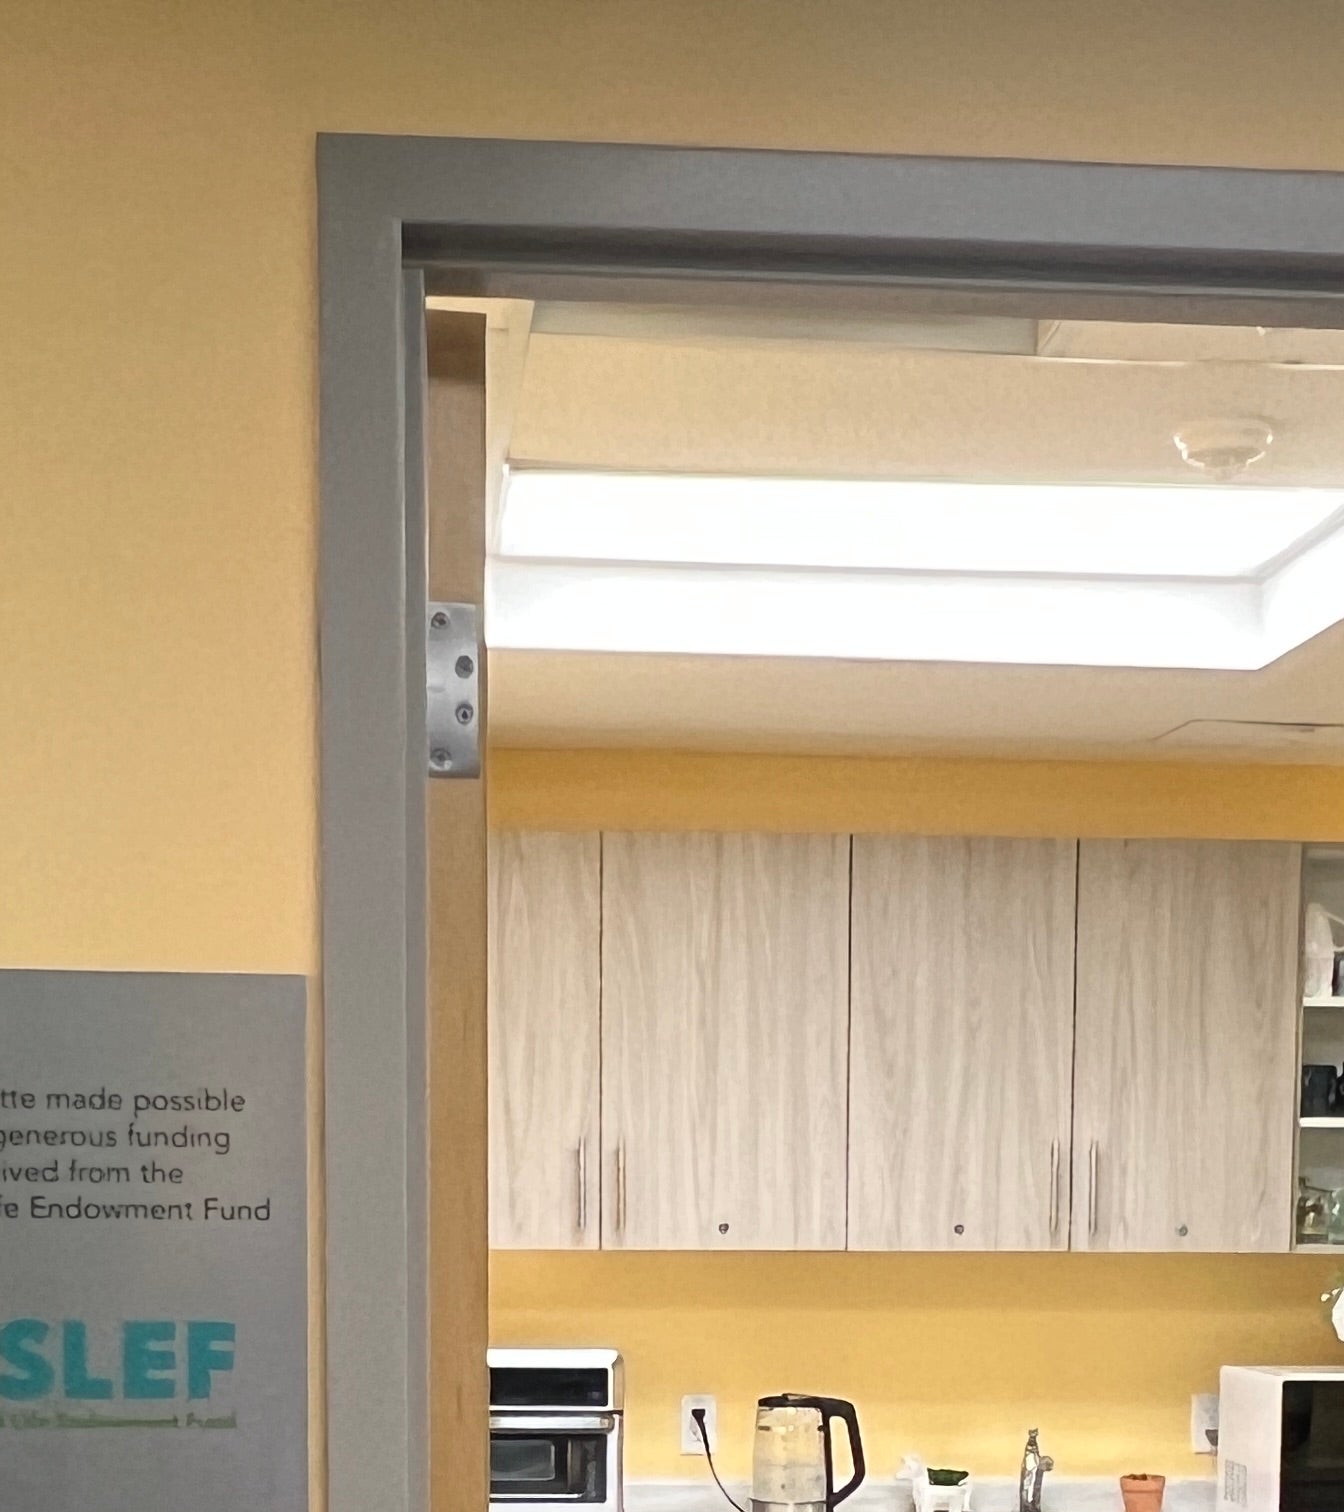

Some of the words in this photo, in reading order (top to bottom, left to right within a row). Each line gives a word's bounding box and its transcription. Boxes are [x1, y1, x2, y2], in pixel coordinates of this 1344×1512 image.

[46, 1086, 124, 1112] made
[131, 1088, 247, 1118] possible
[128, 1122, 232, 1155] funding
[69, 1160, 132, 1185] from
[141, 1162, 186, 1186] the
[30, 1196, 194, 1221] Endowment
[204, 1197, 273, 1223] Fund
